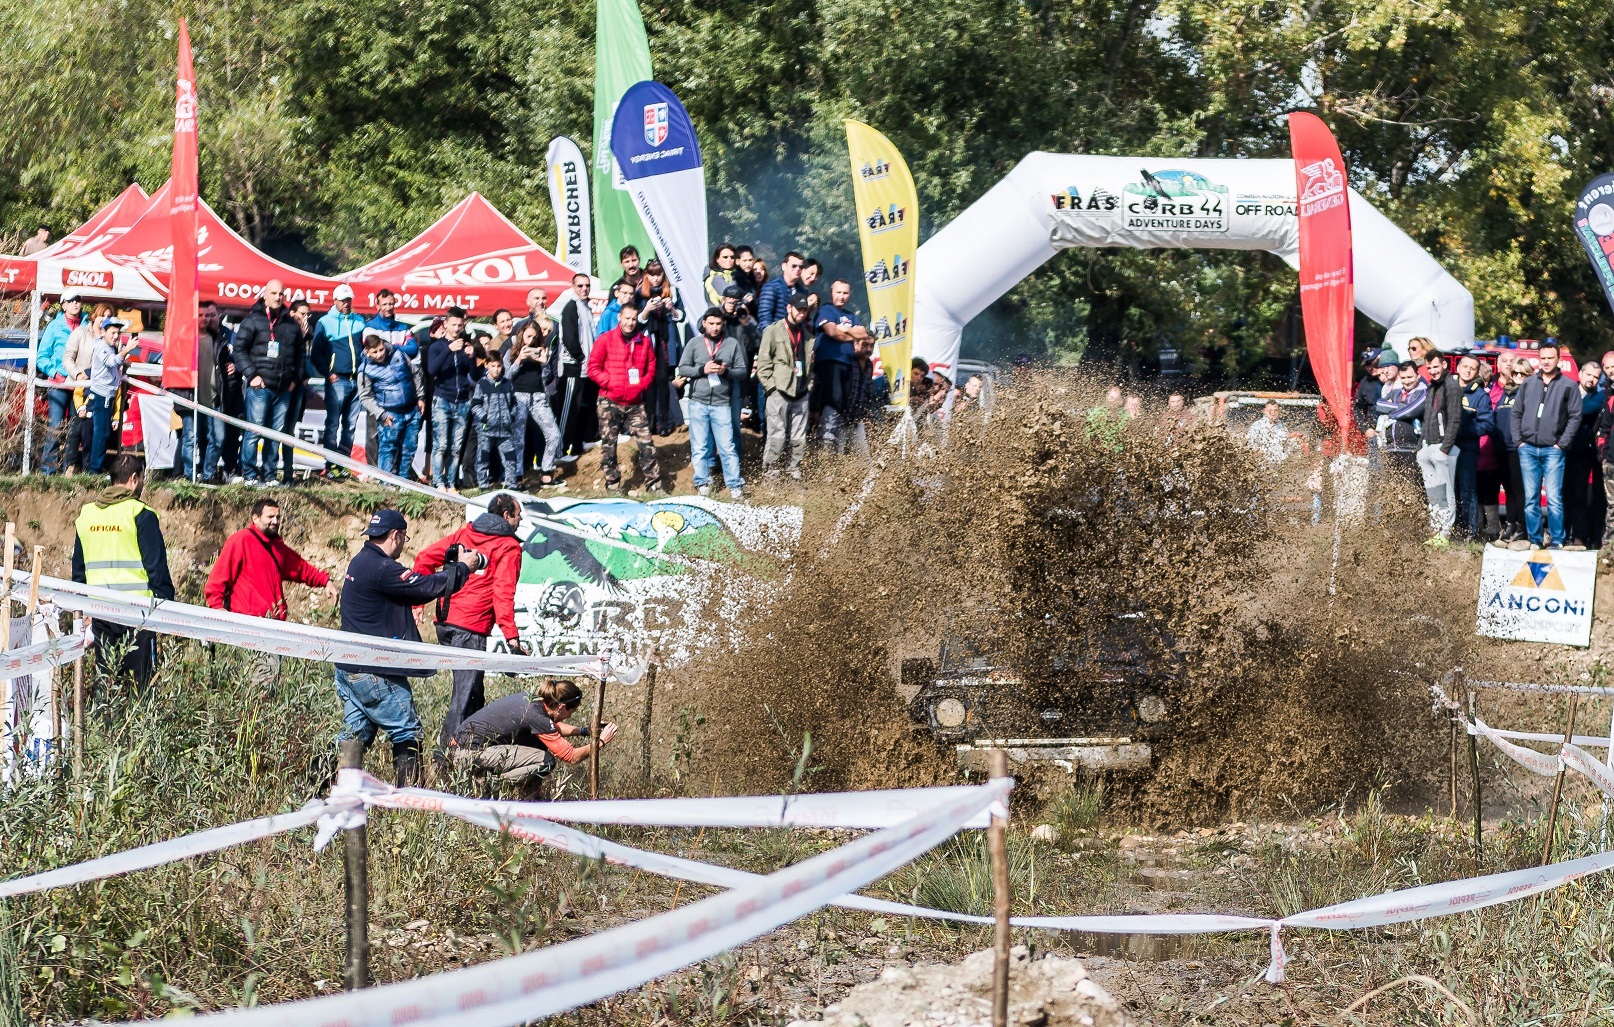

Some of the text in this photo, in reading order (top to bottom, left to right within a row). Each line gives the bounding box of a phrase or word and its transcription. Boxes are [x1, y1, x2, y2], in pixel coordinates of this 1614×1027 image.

[1056, 195, 1115, 210] FRAS
[1236, 204, 1261, 216] OFF
[1128, 218, 1222, 229] ADVENTURE DAYS
[67, 270, 108, 287] SKOL
[401, 255, 549, 291] SKOL
[423, 294, 479, 310] MALT
